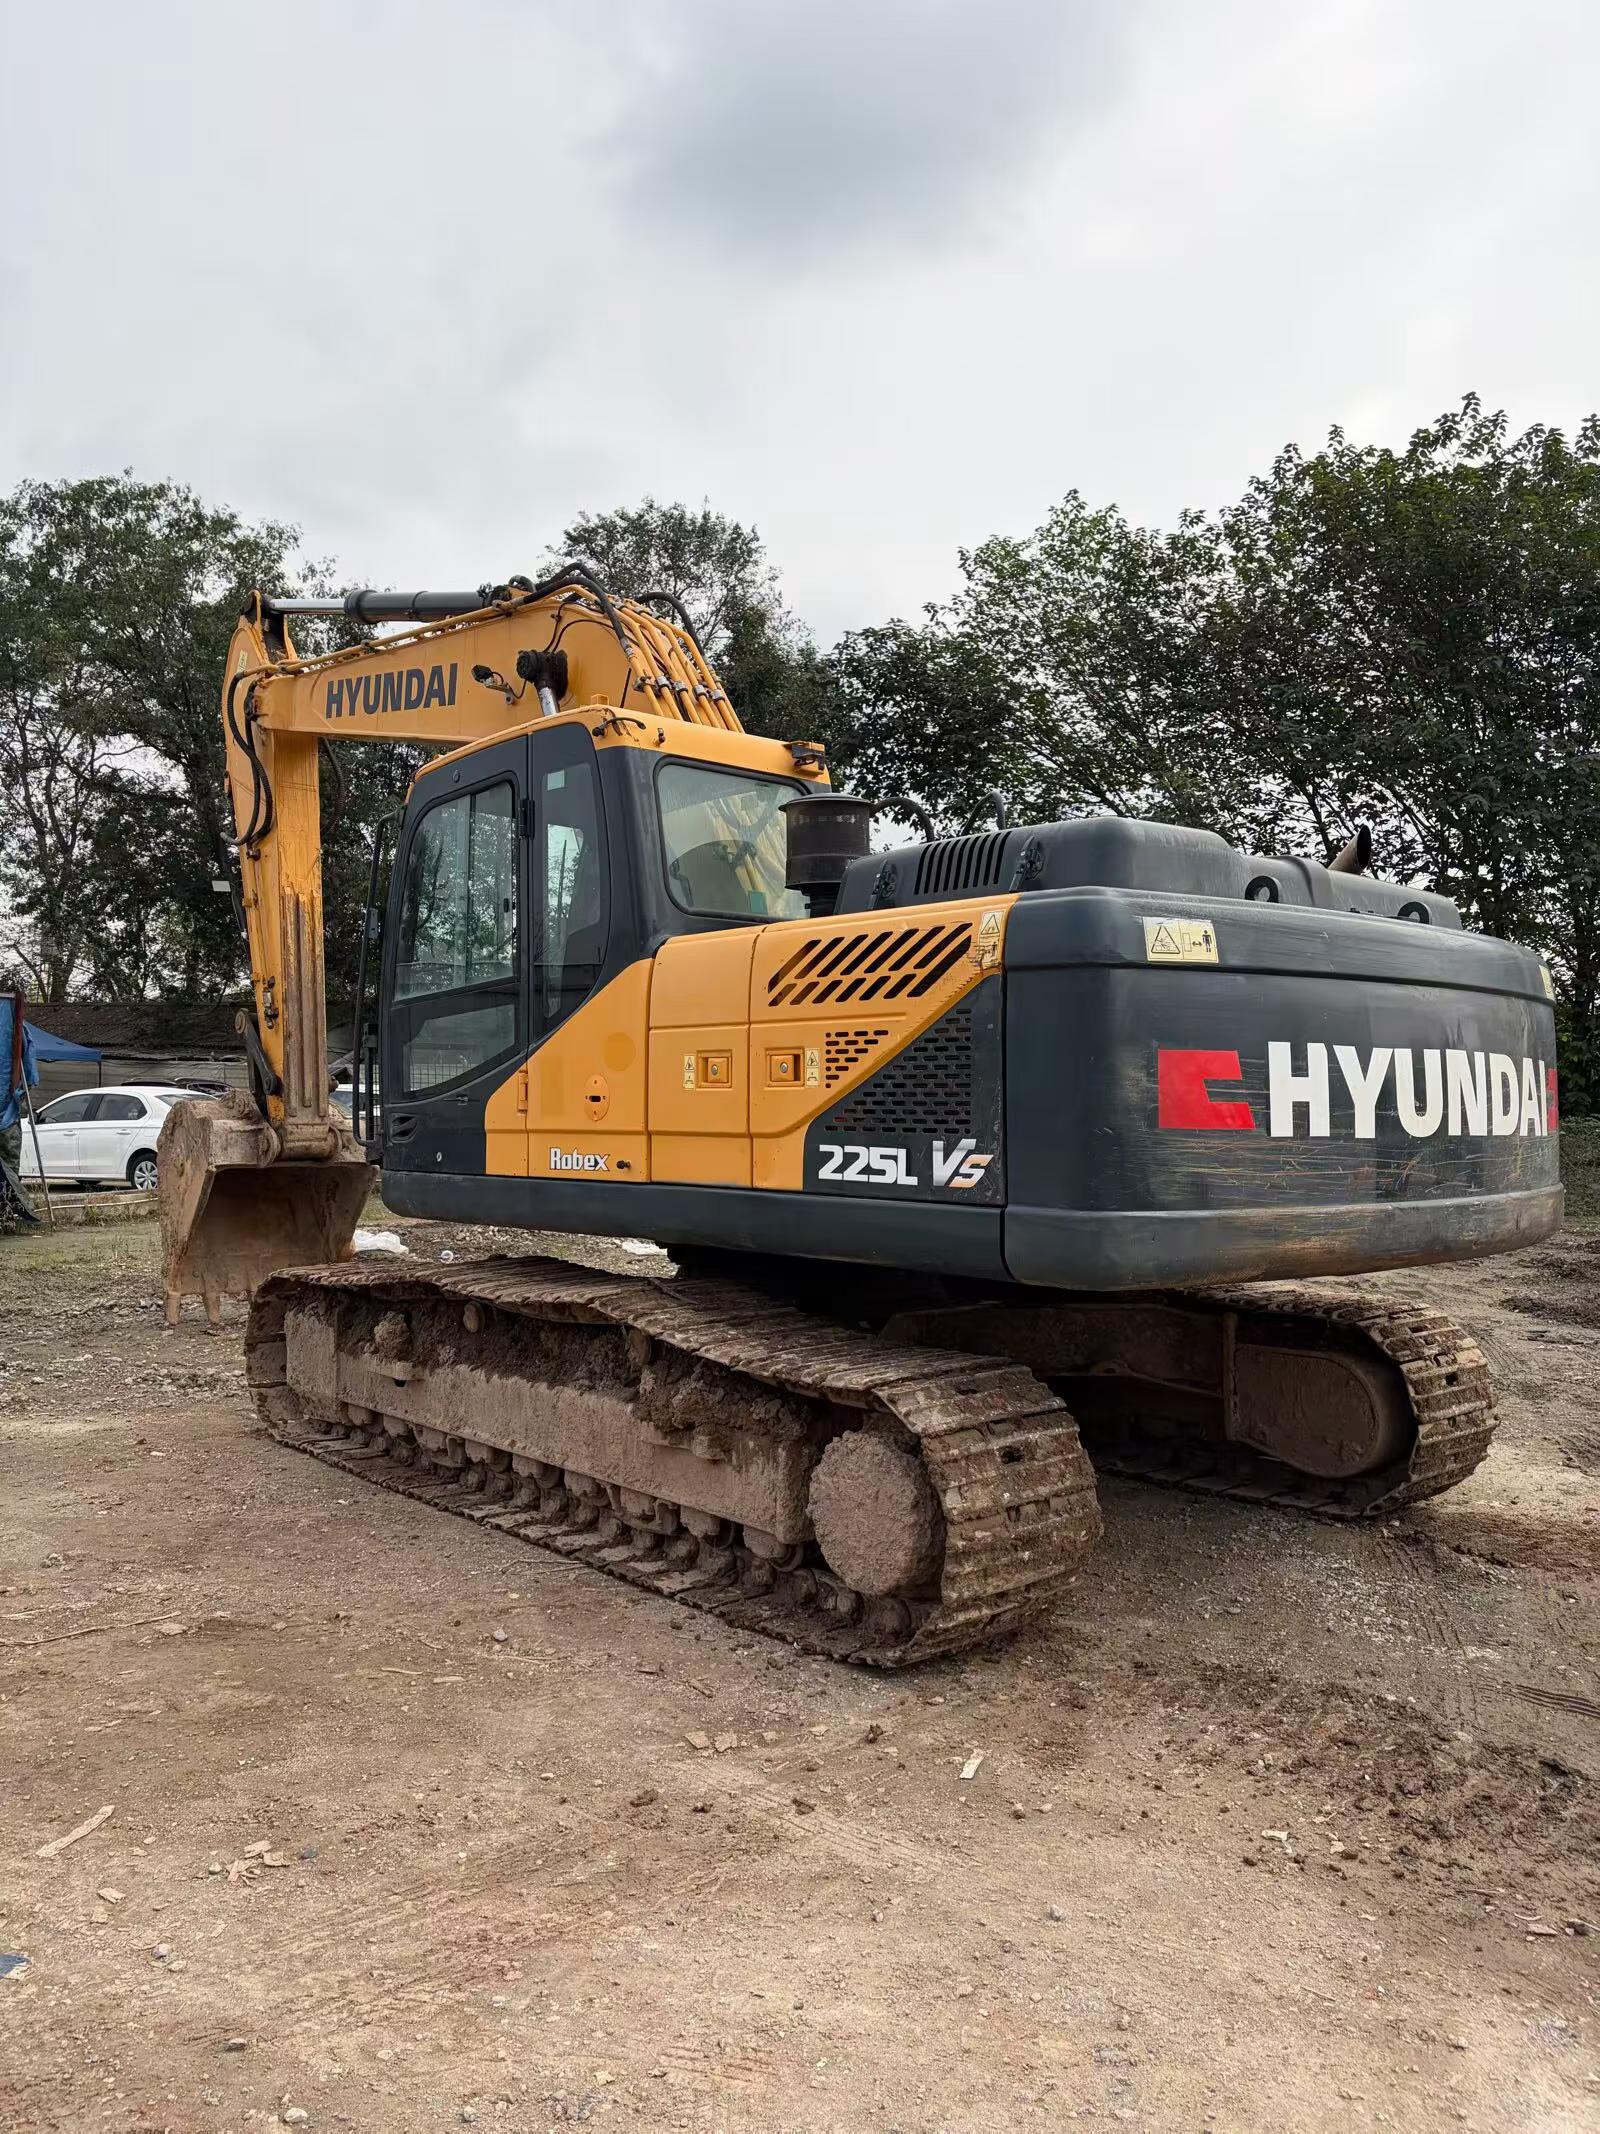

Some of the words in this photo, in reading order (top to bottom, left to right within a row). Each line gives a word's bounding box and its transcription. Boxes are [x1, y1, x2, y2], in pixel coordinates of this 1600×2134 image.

[326, 662, 458, 719] HYUNDAI
[1268, 1041, 1548, 1138] HYUNDAI
[550, 1147, 610, 1172] Robex
[818, 1144, 919, 1186] 225L
